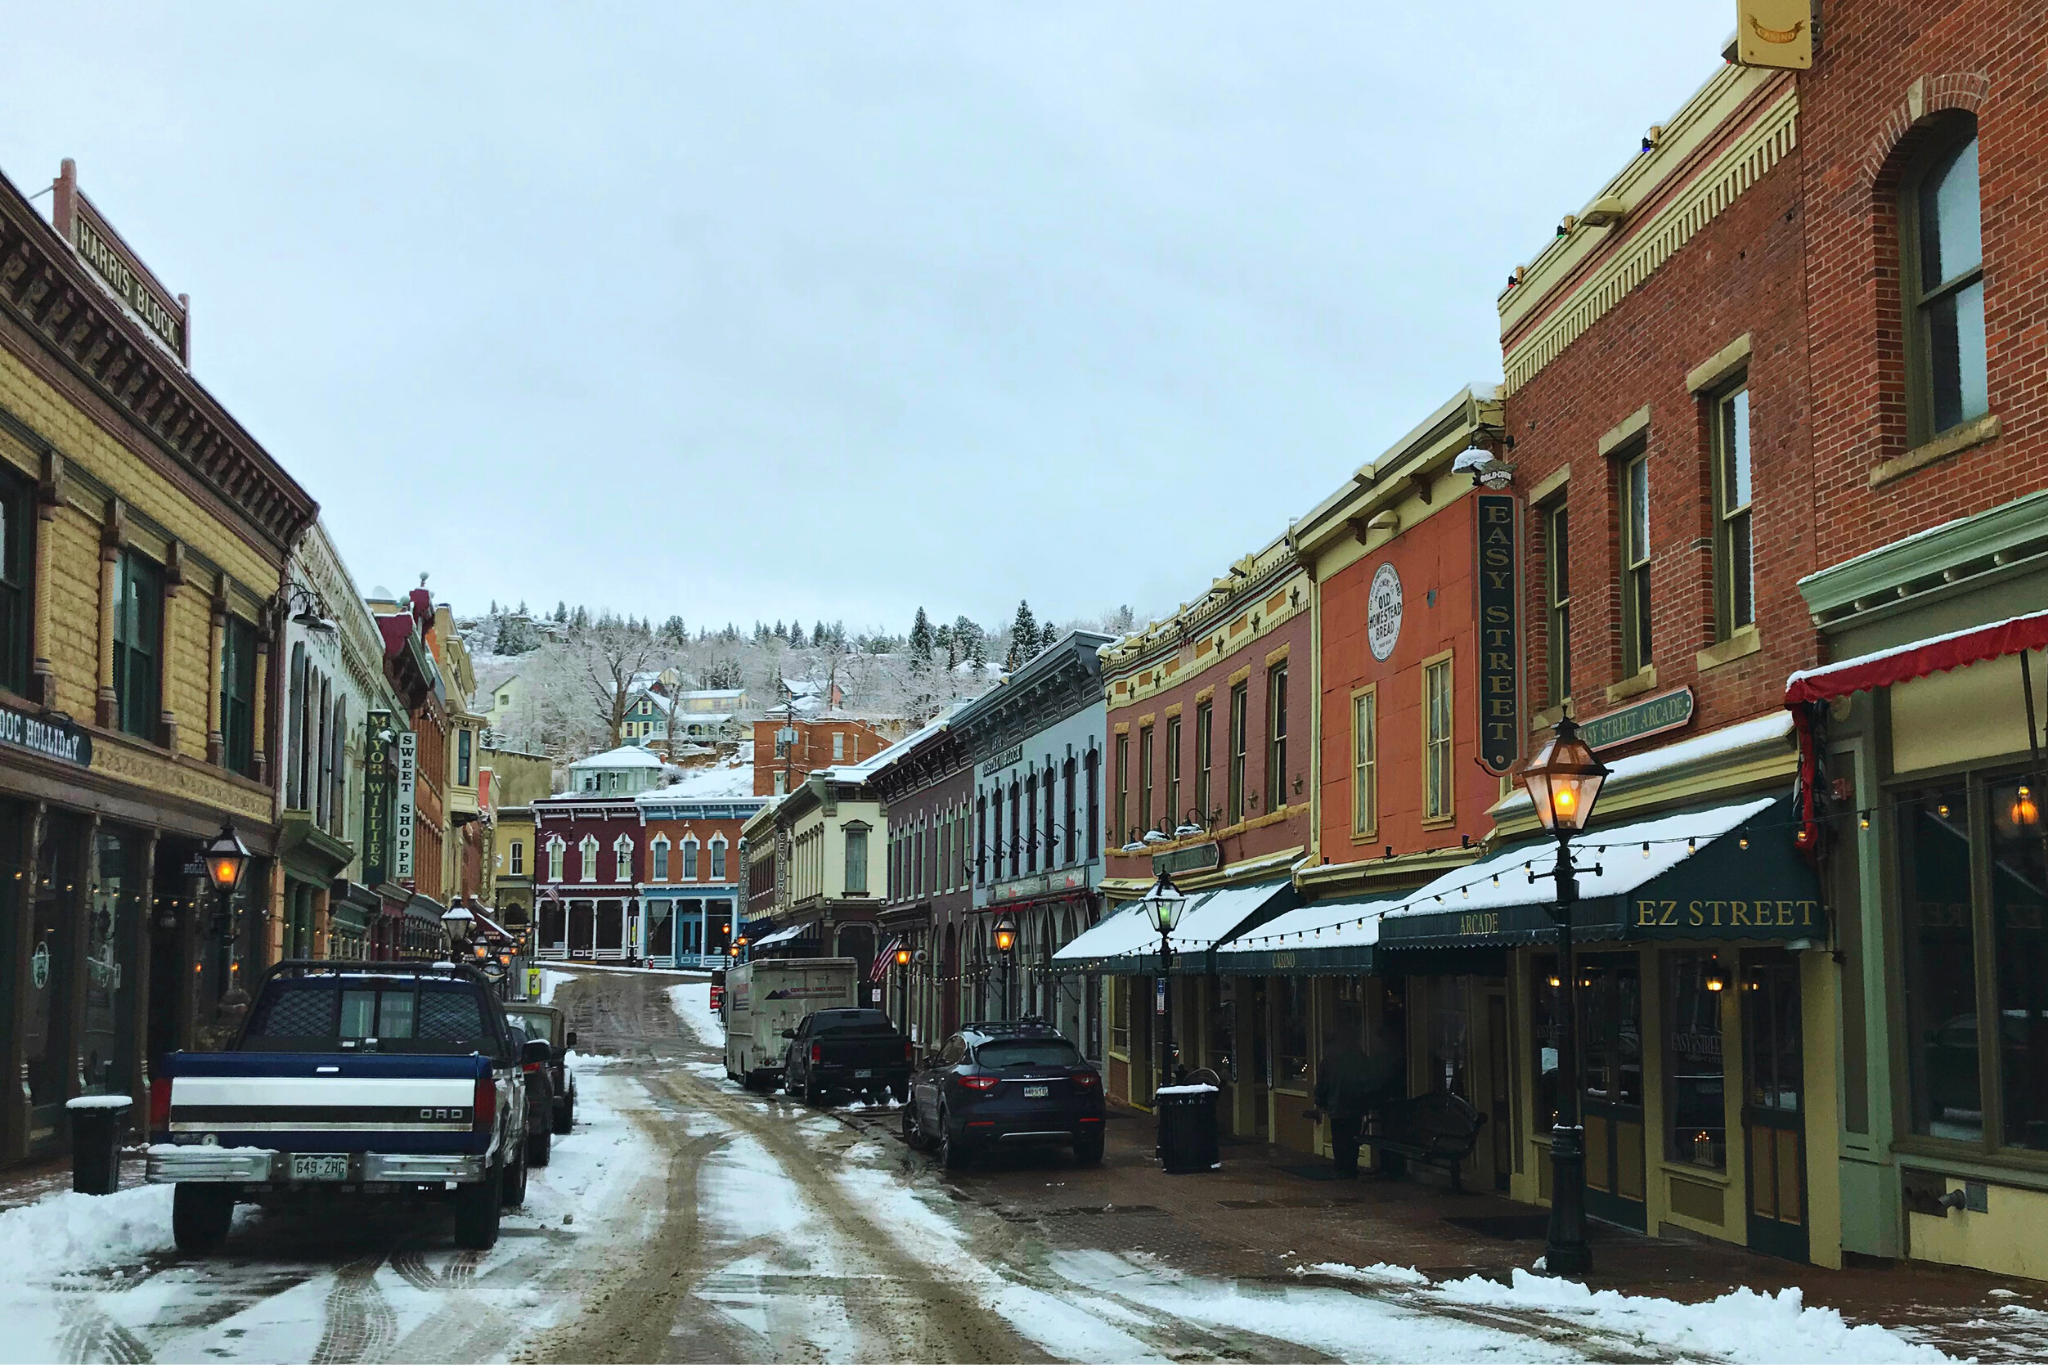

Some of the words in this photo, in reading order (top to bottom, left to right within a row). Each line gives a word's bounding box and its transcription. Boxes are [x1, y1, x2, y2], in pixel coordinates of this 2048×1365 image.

[1757, 27, 1796, 42] CASINO
[80, 220, 130, 298] HARRIS
[1484, 505, 1512, 590] EASY
[1368, 601, 1403, 630] HOMESTEAD
[1378, 592, 1391, 610] OLD
[1375, 620, 1395, 641] BREAD
[1485, 605, 1515, 741] STREET
[26, 717, 80, 761] HOLLIDAY
[1601, 711, 1638, 741] STREET
[401, 735, 415, 793] SWEET
[368, 782, 385, 867] WILLIES
[398, 803, 411, 874] SHOPPE
[740, 854, 748, 912] CENTURY
[777, 832, 787, 902] CENTURY
[1459, 912, 1499, 935] ARCADE
[1636, 900, 1679, 926] EZ
[1688, 900, 1818, 926] STREET
